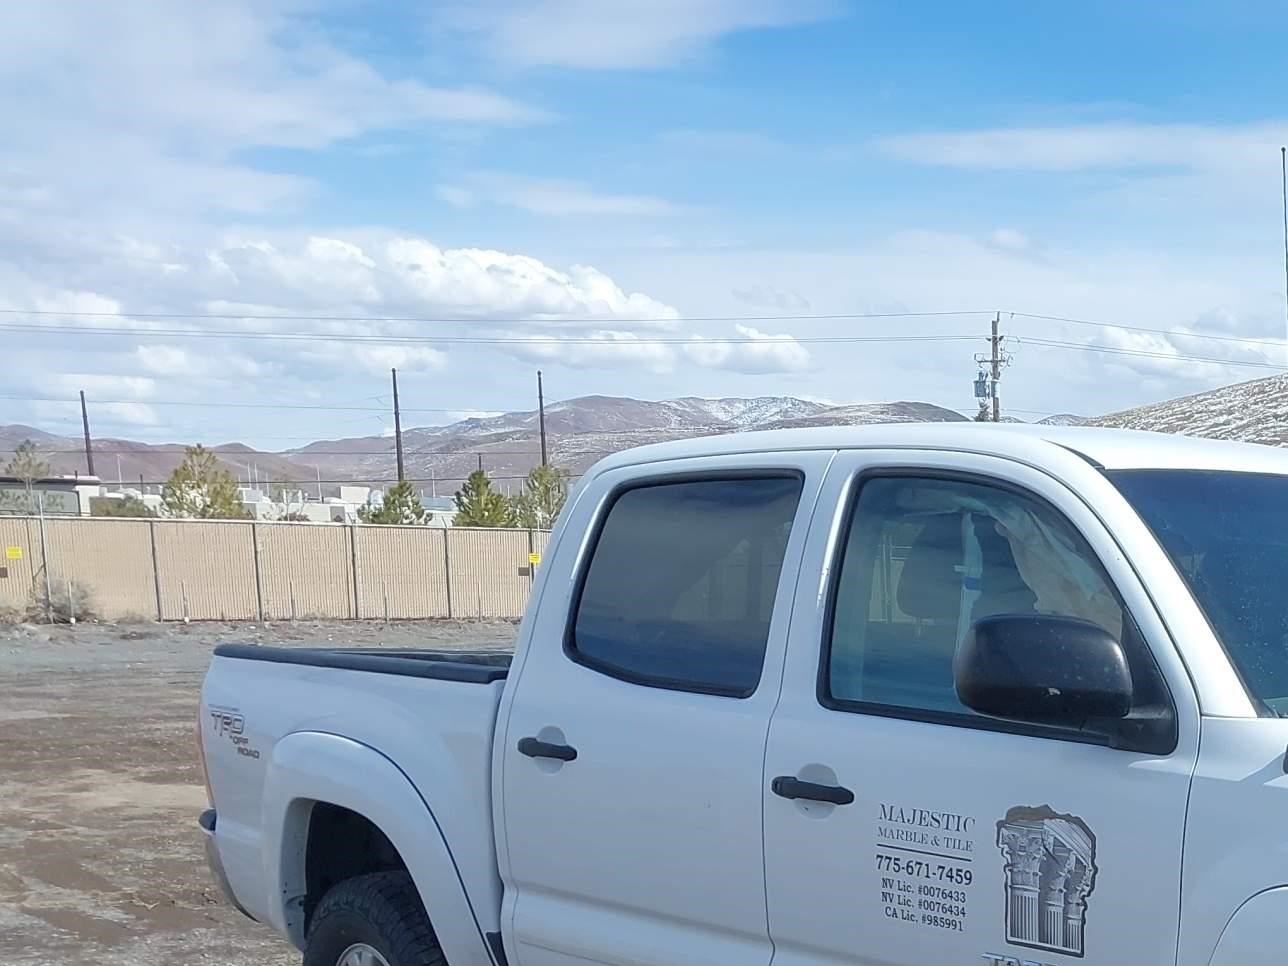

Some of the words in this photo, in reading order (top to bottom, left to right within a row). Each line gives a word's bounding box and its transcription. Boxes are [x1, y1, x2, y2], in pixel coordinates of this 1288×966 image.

[211, 710, 245, 736] TRD
[878, 803, 976, 833] MAJESTIC
[877, 826, 929, 846] MARBLE
[930, 835, 940, 847] &
[943, 836, 973, 852] TILE
[875, 854, 973, 886] 775-671-7459
[881, 877, 894, 891] NV
[897, 881, 914, 894] Lic.
[918, 883, 966, 903] #0076433
[881, 891, 894, 905] NV
[897, 895, 914, 908] Lic.
[918, 897, 966, 917] #0076434
[885, 906, 898, 919] CA
[901, 910, 918, 923] Lic.
[921, 913, 964, 931] #985991
